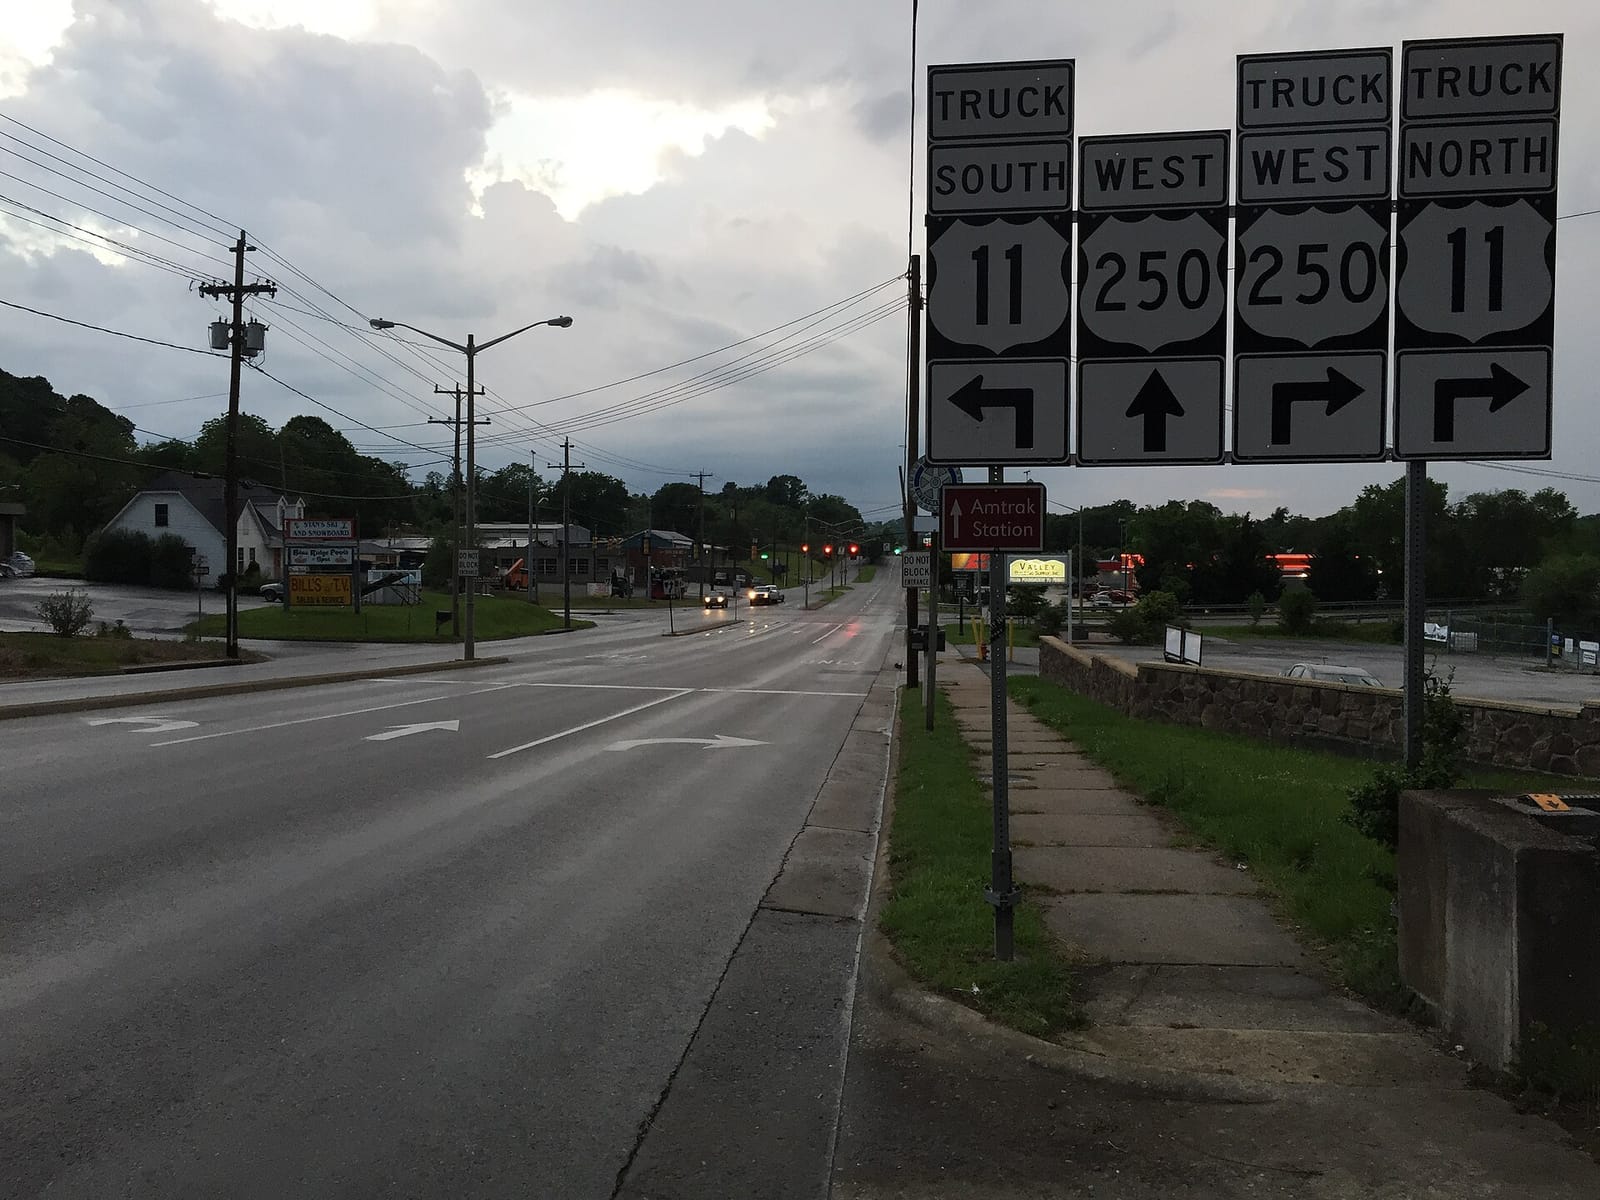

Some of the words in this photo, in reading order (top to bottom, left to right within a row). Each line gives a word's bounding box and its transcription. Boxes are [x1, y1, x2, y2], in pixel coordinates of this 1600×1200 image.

[1246, 73, 1384, 110] TRUCK
[1411, 61, 1552, 99] TRUCK
[935, 84, 1066, 121] TRUCK
[1094, 154, 1214, 192] WEST
[1252, 145, 1380, 185] WEST
[1408, 136, 1548, 179] NORTH
[935, 160, 1066, 196] SOUTH
[971, 243, 1023, 325] 11
[1095, 248, 1211, 312] 250
[1247, 241, 1377, 305] 250
[1447, 225, 1504, 313] 11
[970, 497, 1035, 514] Amtrak
[972, 521, 1034, 537] Station
[904, 555, 915, 564] DO
[915, 555, 930, 564] NOT
[904, 567, 931, 577] BLOCK
[1019, 562, 1056, 571] VALLEY
[291, 577, 322, 592] BILL'S
[904, 578, 930, 586] ENTRANCE
